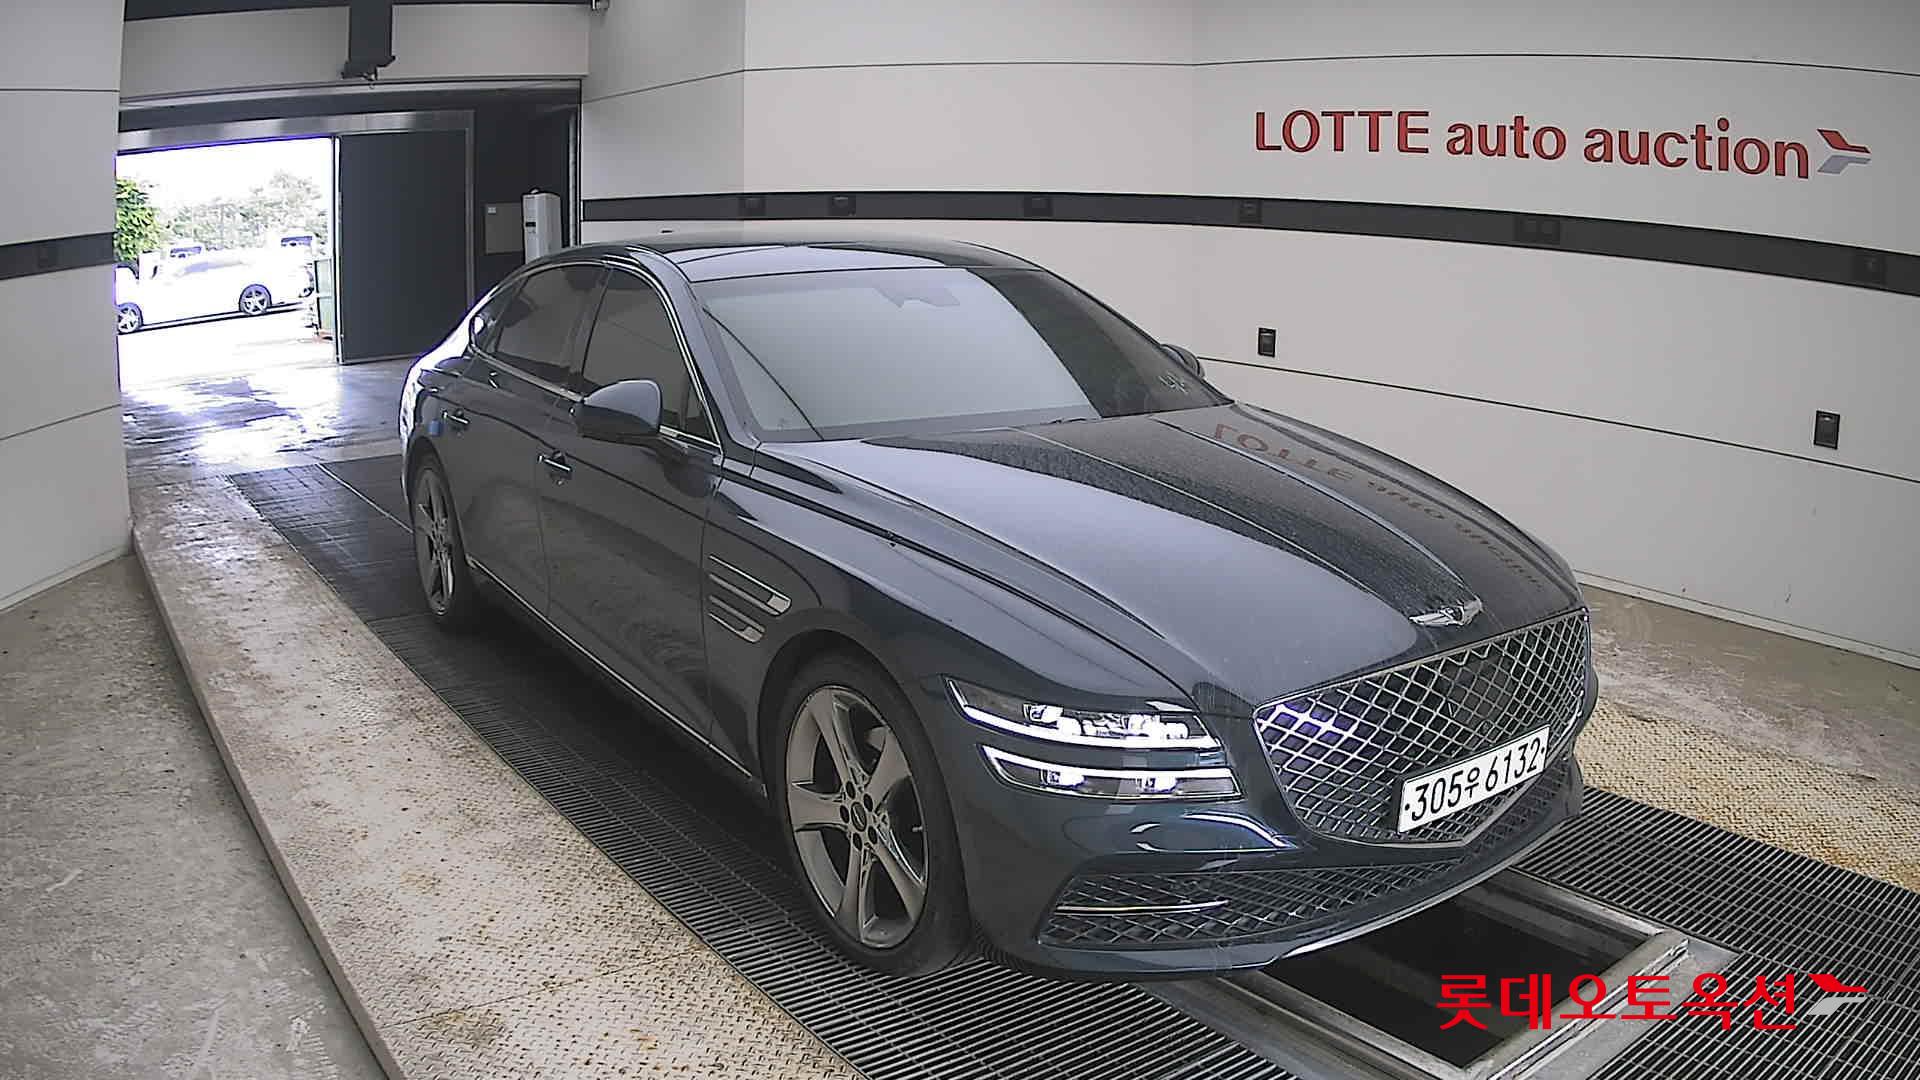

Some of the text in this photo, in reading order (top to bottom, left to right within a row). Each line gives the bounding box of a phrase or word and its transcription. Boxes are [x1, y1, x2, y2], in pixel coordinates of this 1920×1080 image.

[1255, 110, 1810, 179] LOTTE auto auction
